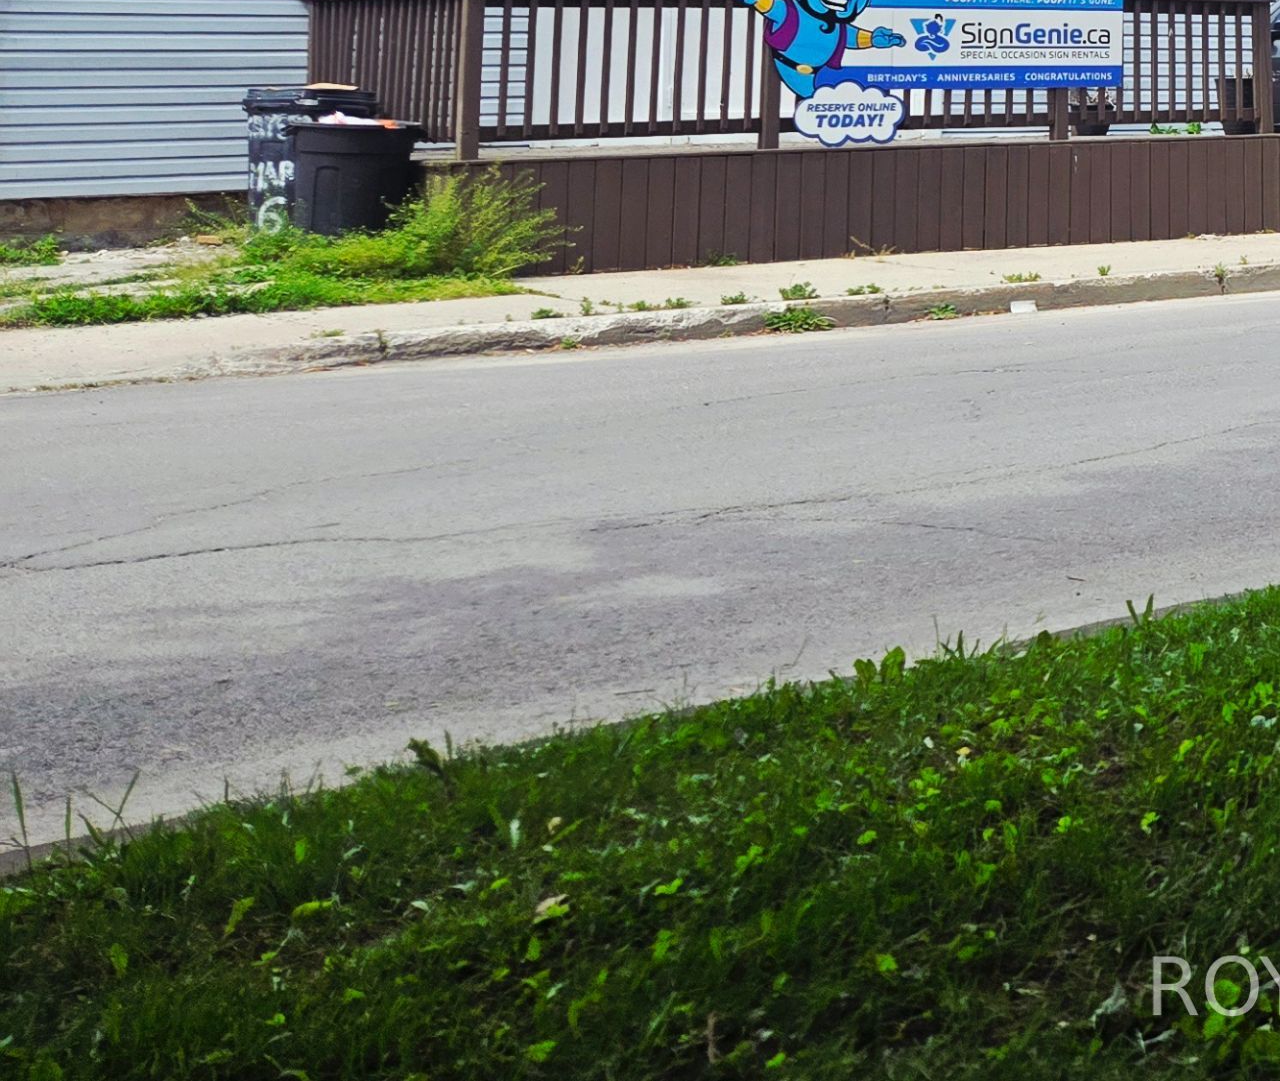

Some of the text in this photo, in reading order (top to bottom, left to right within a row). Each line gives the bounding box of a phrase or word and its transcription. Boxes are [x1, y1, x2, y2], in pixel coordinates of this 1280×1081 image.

[961, 22, 1111, 49] SignGenie.ca
[960, 51, 1110, 59] SPECIAL OCCASION SIGN RENTALS
[867, 72, 1113, 83] BIRTHDAY'S ANNIVERSARIES CONGRATULATIONS
[807, 102, 897, 112] RESERVE ONLINE
[815, 114, 885, 128] TODAY!
